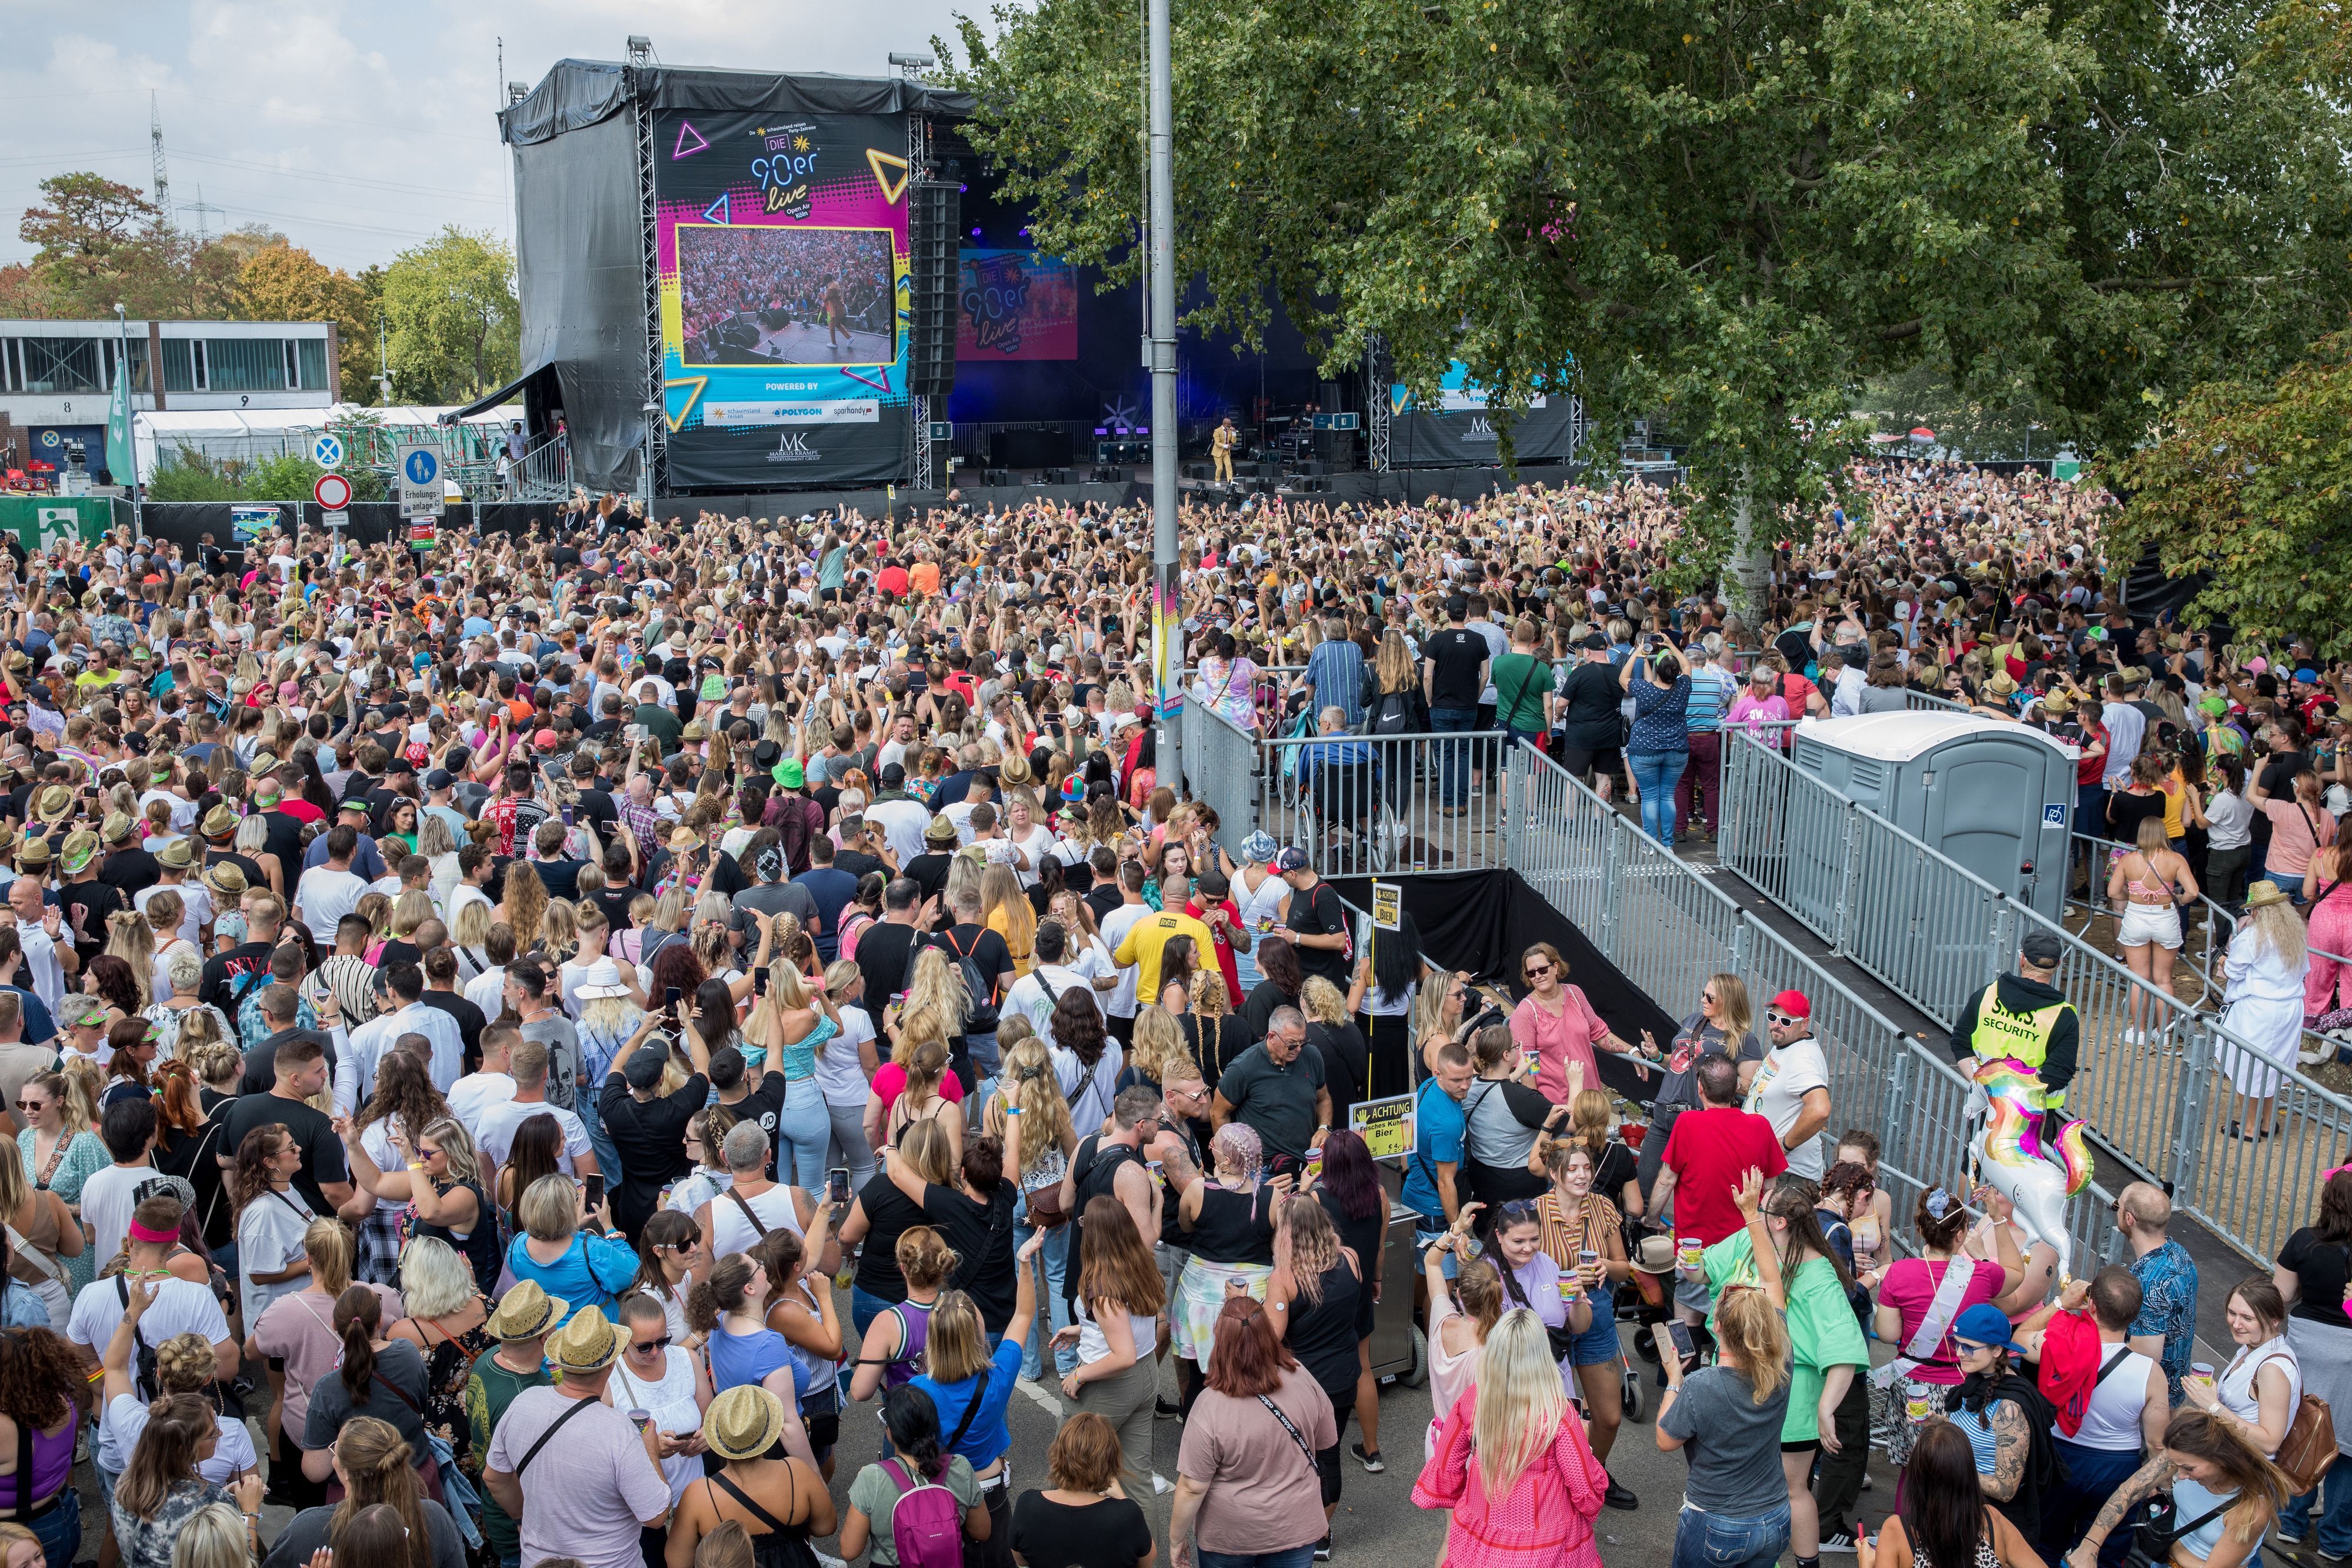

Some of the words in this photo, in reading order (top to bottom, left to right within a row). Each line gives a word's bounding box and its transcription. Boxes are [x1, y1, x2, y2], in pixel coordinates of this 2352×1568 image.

[767, 123, 793, 132] schauinsland
[789, 125, 816, 133] Party-Zeitreise
[770, 138, 786, 151] DIE
[751, 153, 817, 190] 90er
[767, 185, 807, 212] live
[786, 206, 801, 215] Open
[983, 270, 998, 283] DIE
[966, 286, 1026, 324] 90er
[979, 318, 1016, 346] live
[998, 339, 1011, 348] Open
[1005, 345, 1018, 353] Köln
[64, 402, 71, 412] 8
[241, 395, 249, 407] 9
[834, 406, 866, 416] sparhandy
[1471, 417, 1492, 433] MK
[779, 433, 808, 451] MK
[406, 490, 440, 500] Erholungs-
[412, 500, 433, 511] anlage
[1172, 659, 1183, 671] Conta
[1382, 891, 1397, 901] ACHTUNG
[1380, 908, 1393, 922] BIER
[1983, 1017, 2040, 1042] SECURITY
[1372, 1102, 1410, 1119] ACHTUNG
[763, 1115, 774, 1127] JD
[1360, 1124, 1385, 1133] Frisches
[1388, 1119, 1409, 1127] Kühles
[1376, 1129, 1394, 1138] Bier
[1281, 1415, 1295, 1432] adidas
[1298, 1437, 1308, 1451] adidas
